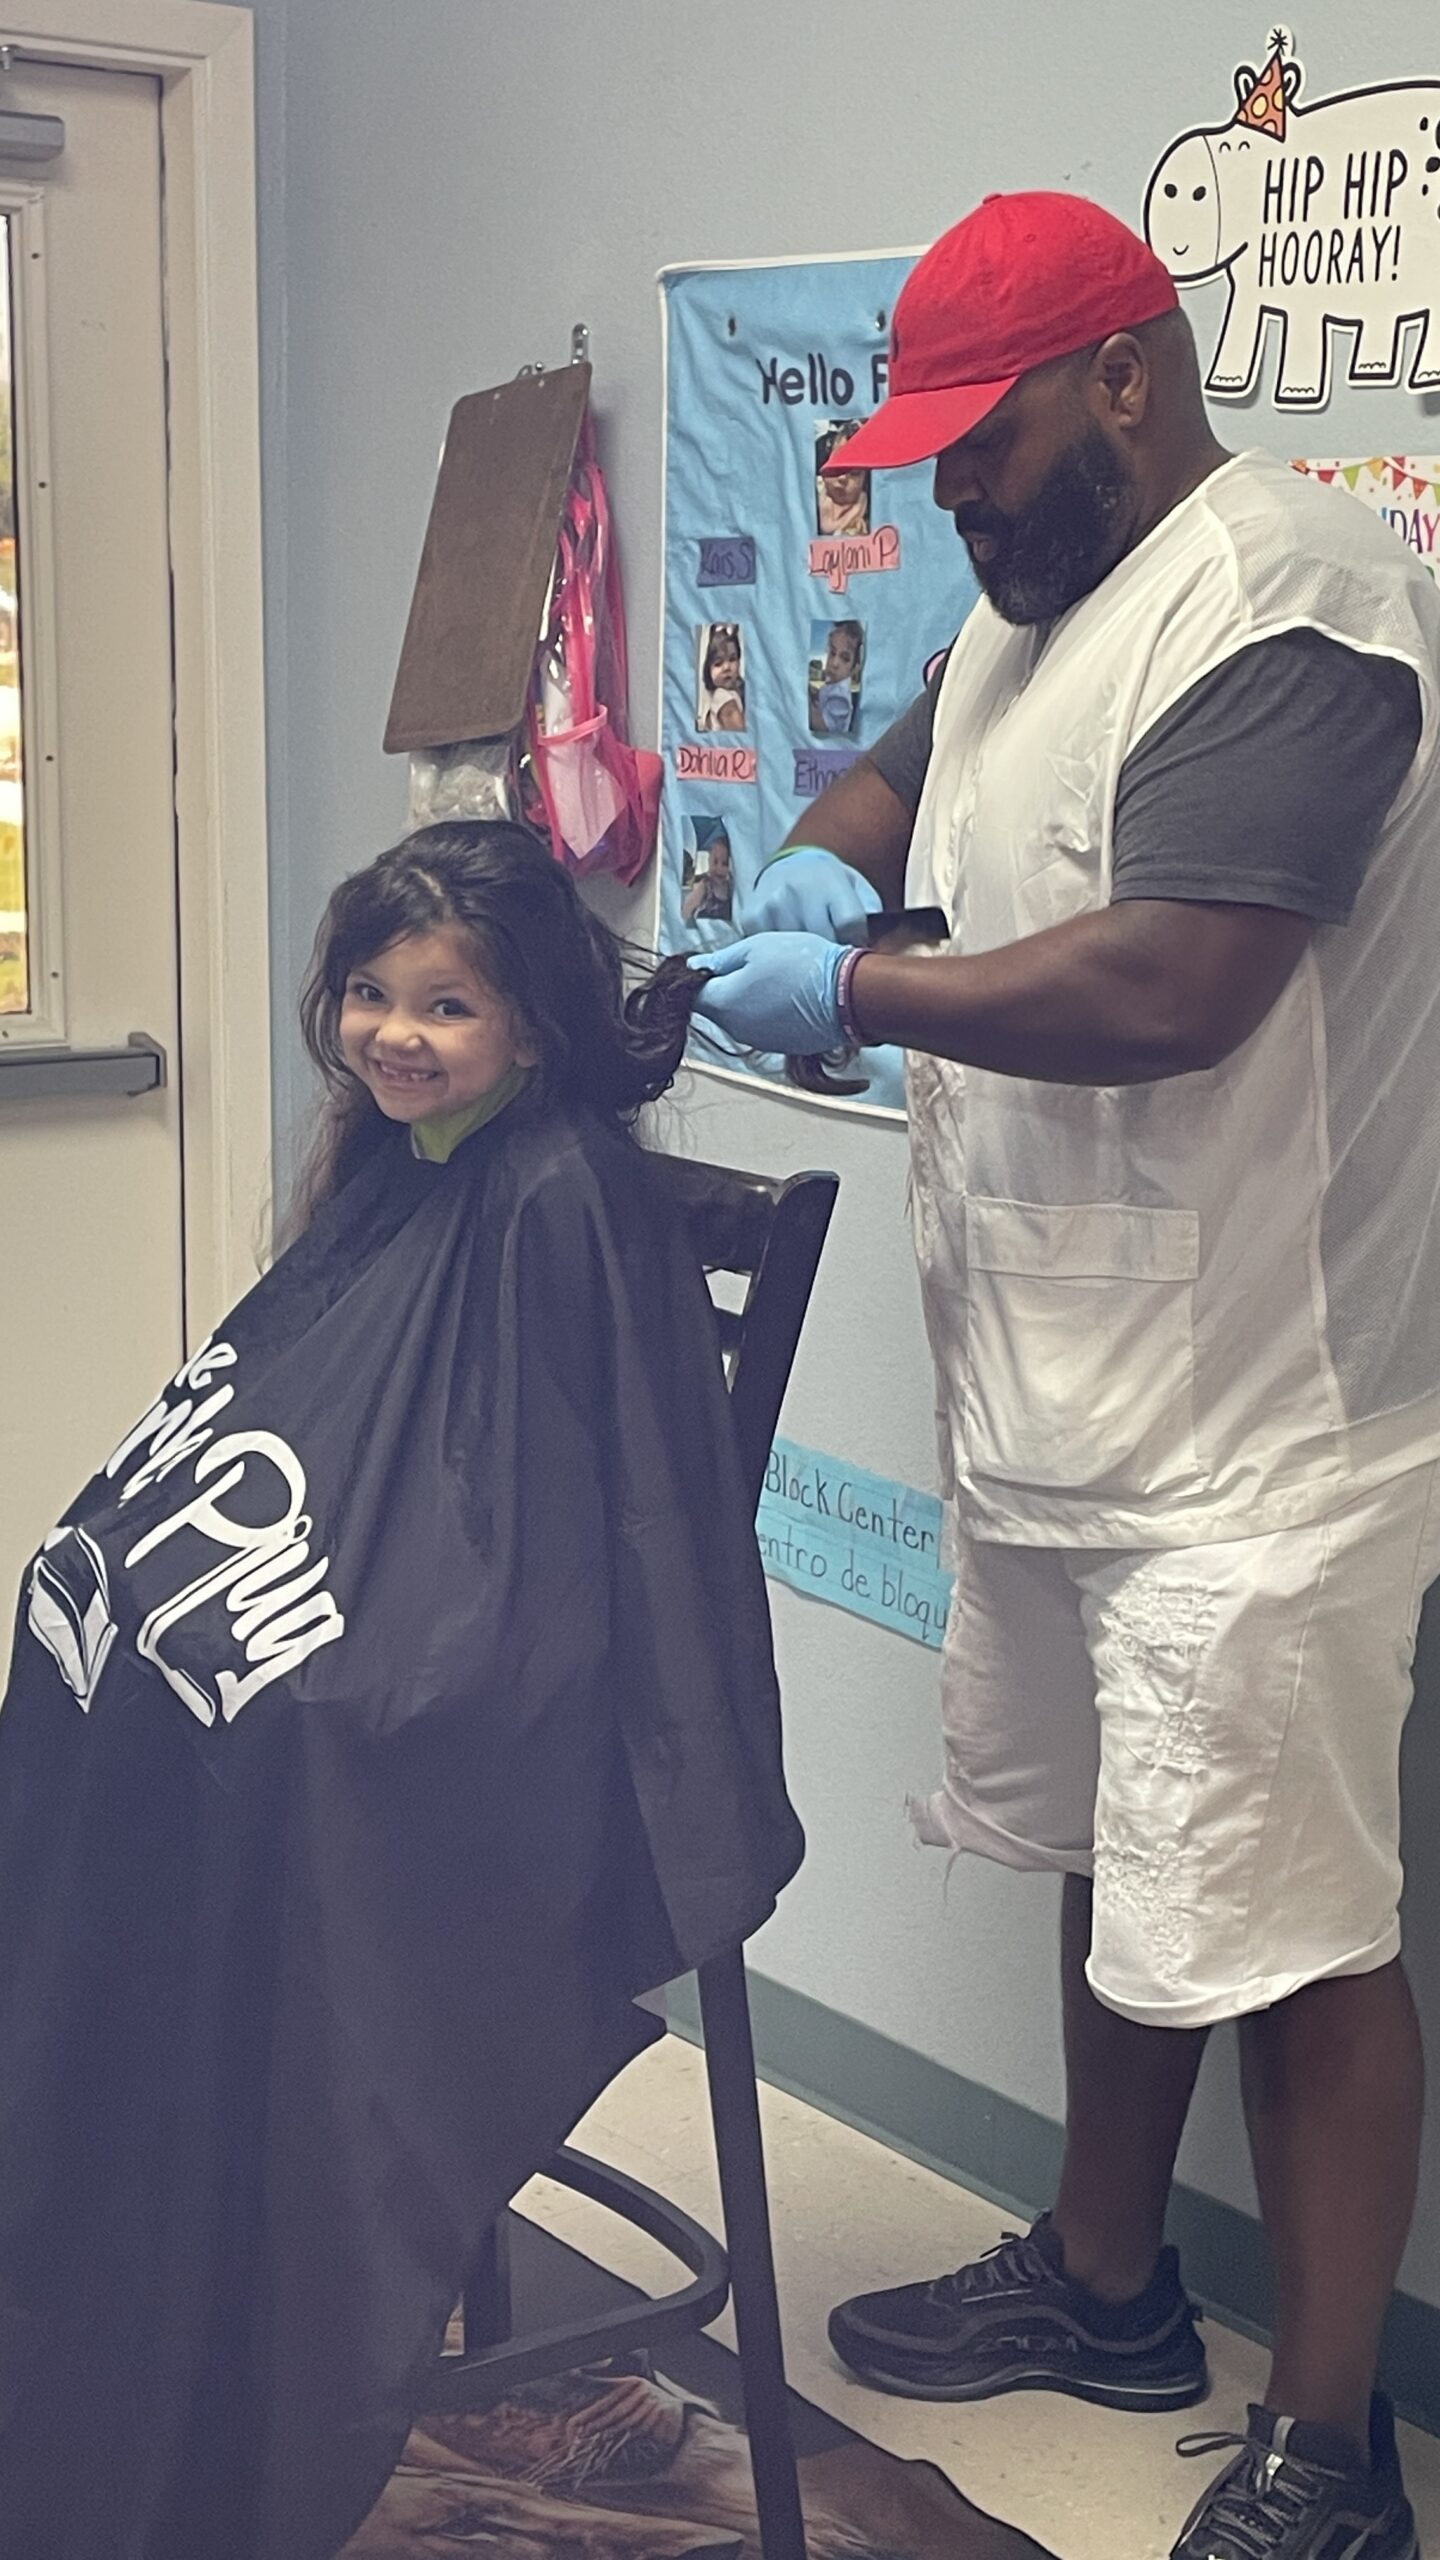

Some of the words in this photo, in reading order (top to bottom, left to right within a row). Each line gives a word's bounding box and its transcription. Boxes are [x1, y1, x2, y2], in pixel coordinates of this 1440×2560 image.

[1263, 155, 1325, 225] HIP
[1343, 148, 1408, 220] HIP
[1257, 224, 1401, 288] HOORAY!
[755, 351, 854, 406] Hello
[870, 353, 889, 404] F
[873, 525, 900, 567] P
[1381, 506, 1440, 554] DAY
[736, 542, 751, 580] S
[732, 750, 753, 780] R
[794, 758, 849, 792] Etha
[764, 1450, 831, 1517] Block
[837, 1481, 935, 1553] Center
[758, 1524, 828, 1578] entro
[840, 1549, 871, 1599] de
[880, 1563, 948, 1641] bloqu
